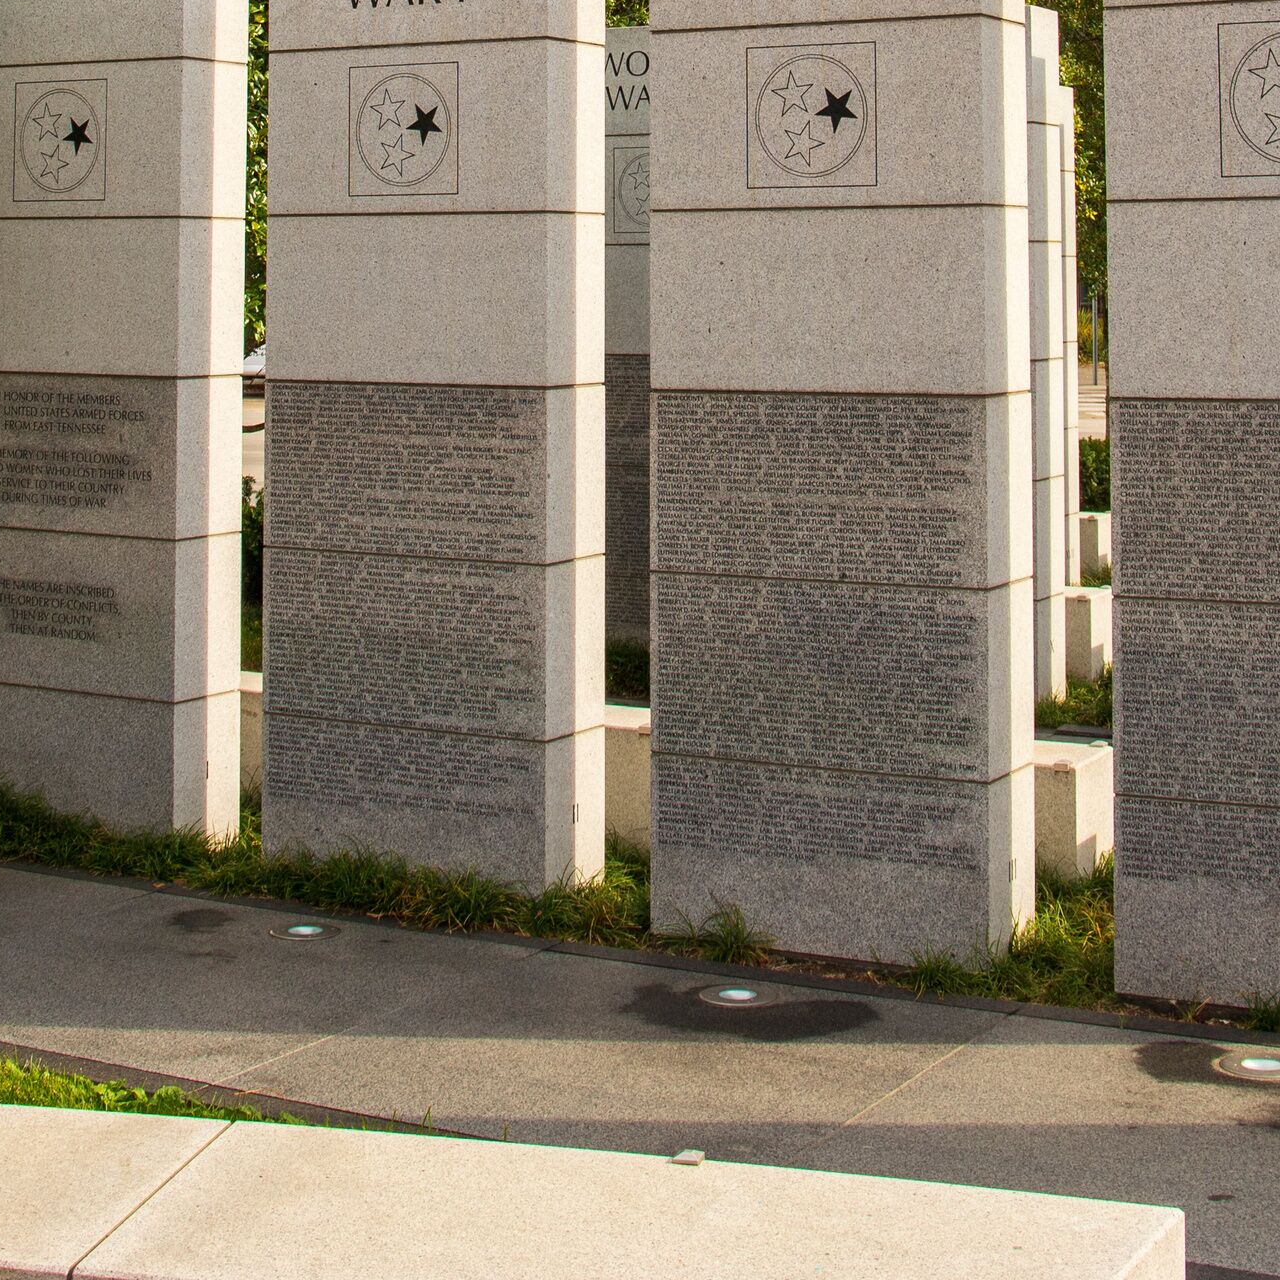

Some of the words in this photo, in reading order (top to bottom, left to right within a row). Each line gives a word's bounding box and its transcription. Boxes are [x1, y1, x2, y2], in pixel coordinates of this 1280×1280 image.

[4, 392, 39, 402] HONOR
[42, 393, 55, 403] OF
[58, 393, 73, 404] THE
[78, 395, 120, 405] MEMBERS
[4, 406, 37, 416] UNITED
[40, 408, 70, 418] STATES
[72, 409, 105, 420] ARMED
[109, 410, 144, 421] FORCES
[4, 420, 30, 431] FROM
[33, 422, 53, 432] EAST
[57, 423, 106, 434] TENNESSEE
[36, 450, 49, 461] OF
[53, 451, 68, 462] THE
[72, 452, 130, 466] FOLLOWING
[6, 463, 42, 474] WOMEN
[45, 466, 70, 477] WHO
[73, 467, 95, 478] LOST
[98, 468, 125, 480] THEIR
[128, 470, 152, 481] LIVES
[35, 479, 47, 490] TO
[50, 480, 75, 492] THEIR
[78, 482, 125, 495] COUNTRY
[1, 491, 38, 504] DURING
[41, 494, 67, 506] TIMES
[69, 496, 82, 508] OF
[84, 497, 106, 508] WAR
[12, 581, 44, 592] NAMES
[46, 583, 64, 594] ARE
[66, 585, 115, 599] INSCRIBED
[0, 593, 16, 604] THE
[18, 595, 49, 607] ORDER
[52, 598, 65, 609] OF
[10, 608, 36, 621] THEN
[38, 612, 49, 622] BY
[9, 623, 35, 635] THEN
[37, 626, 49, 637] AT
